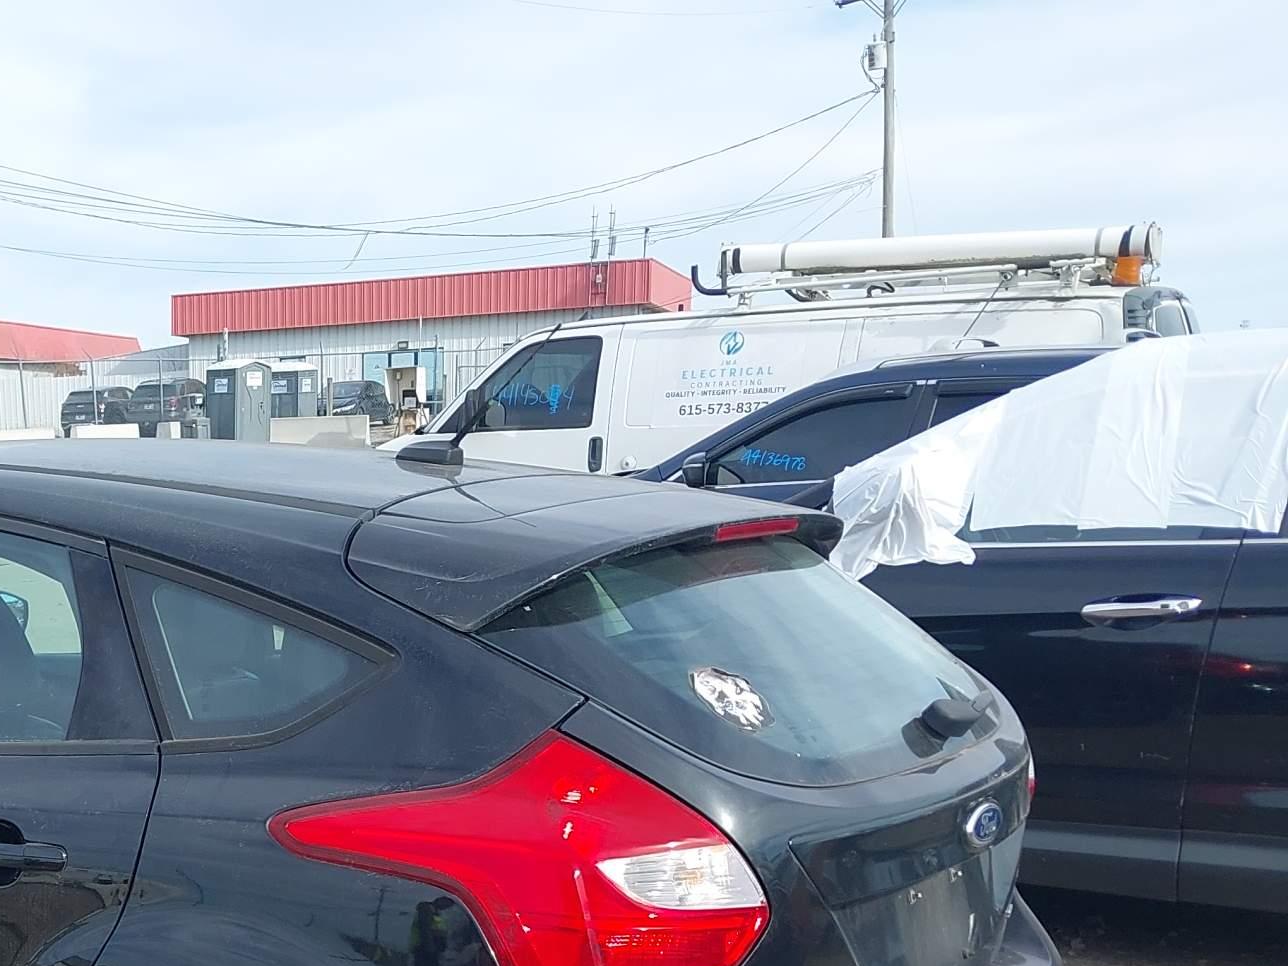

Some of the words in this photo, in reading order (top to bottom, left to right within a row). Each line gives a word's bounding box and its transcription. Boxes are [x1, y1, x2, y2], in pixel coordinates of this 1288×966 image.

[682, 366, 774, 379] ELECTRICAL
[690, 379, 763, 389] CONTRACTING
[665, 390, 695, 398] QUALITY
[701, 388, 737, 397] INTEGRITY
[743, 386, 787, 395] RELIABILITY
[679, 401, 769, 416] 615-573-837
